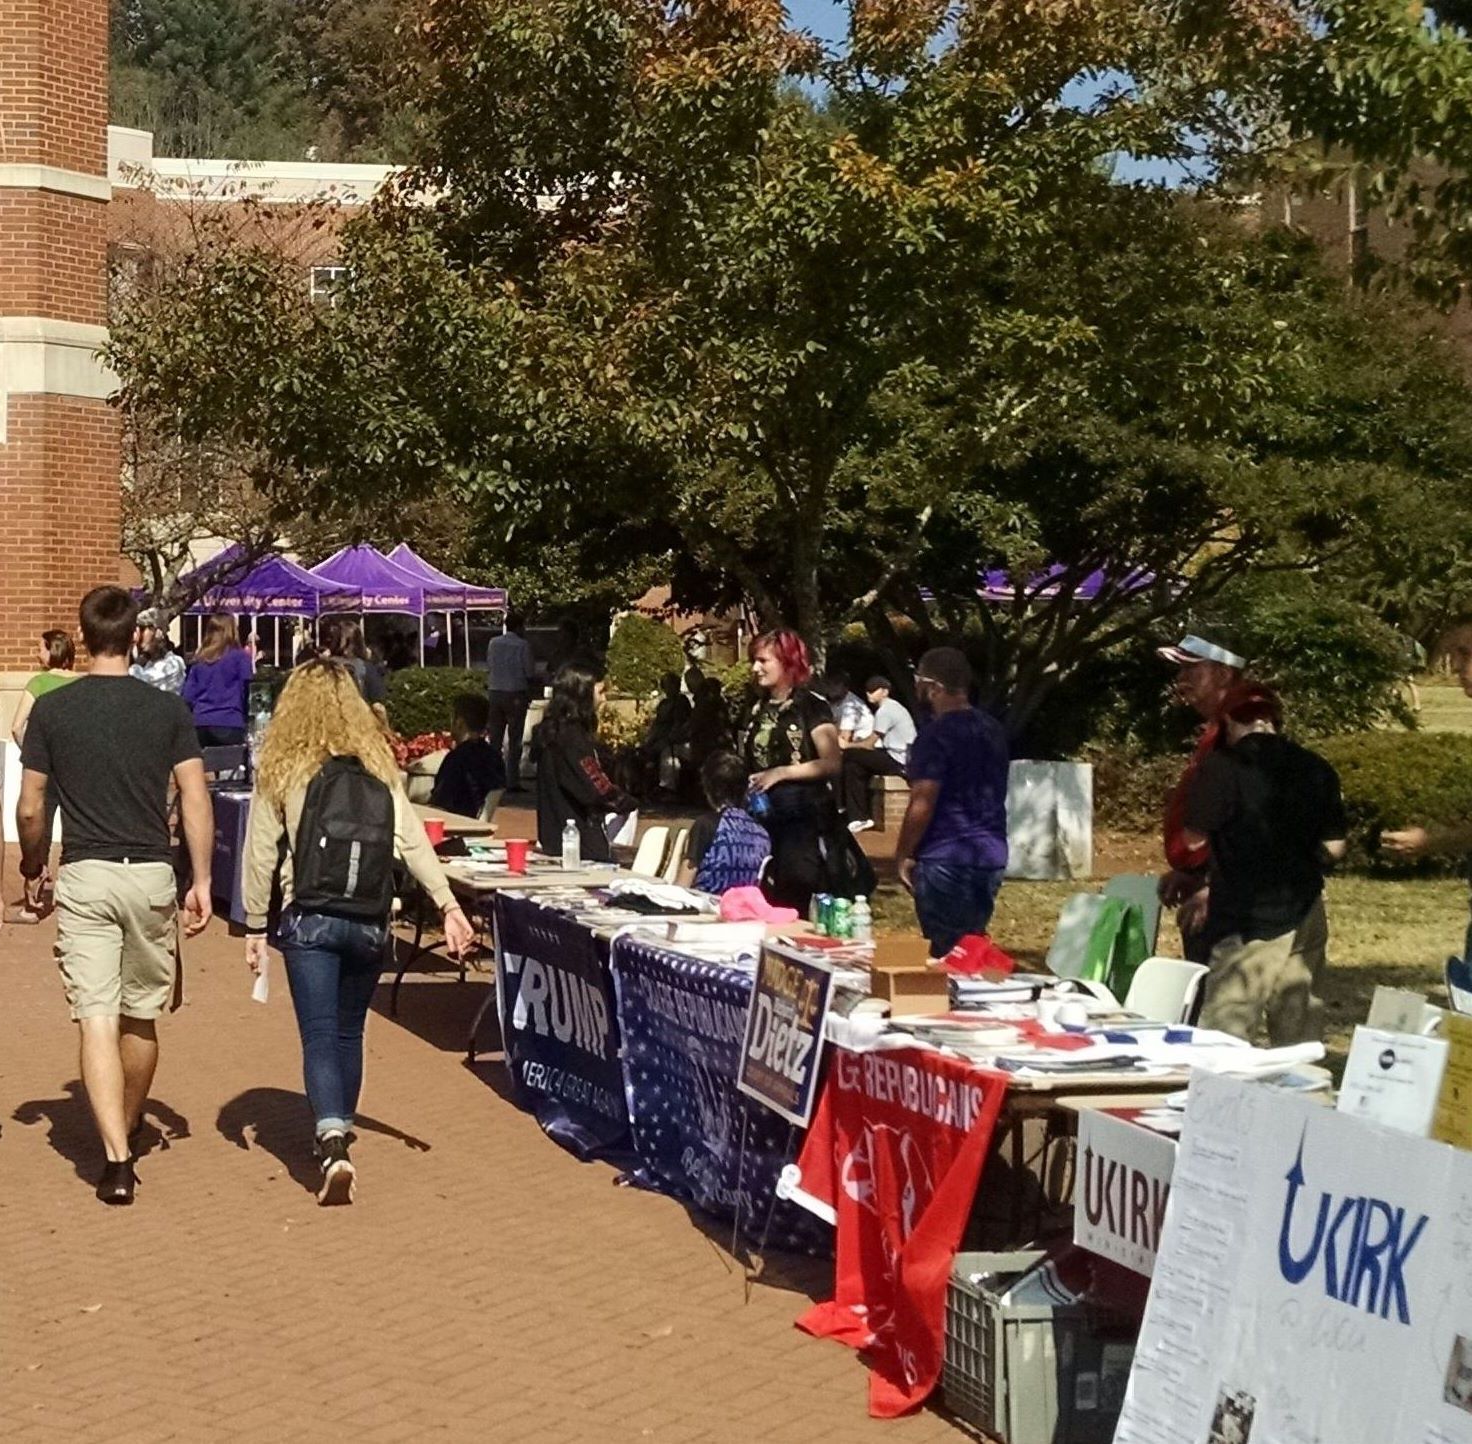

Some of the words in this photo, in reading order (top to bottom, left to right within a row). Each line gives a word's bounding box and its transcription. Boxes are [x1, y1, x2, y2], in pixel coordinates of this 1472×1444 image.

[503, 951, 609, 1061] TRUMP
[748, 991, 815, 1086] Dietz
[1084, 1144, 1171, 1254] UKIRK
[1279, 1155, 1431, 1326] UKIRK
